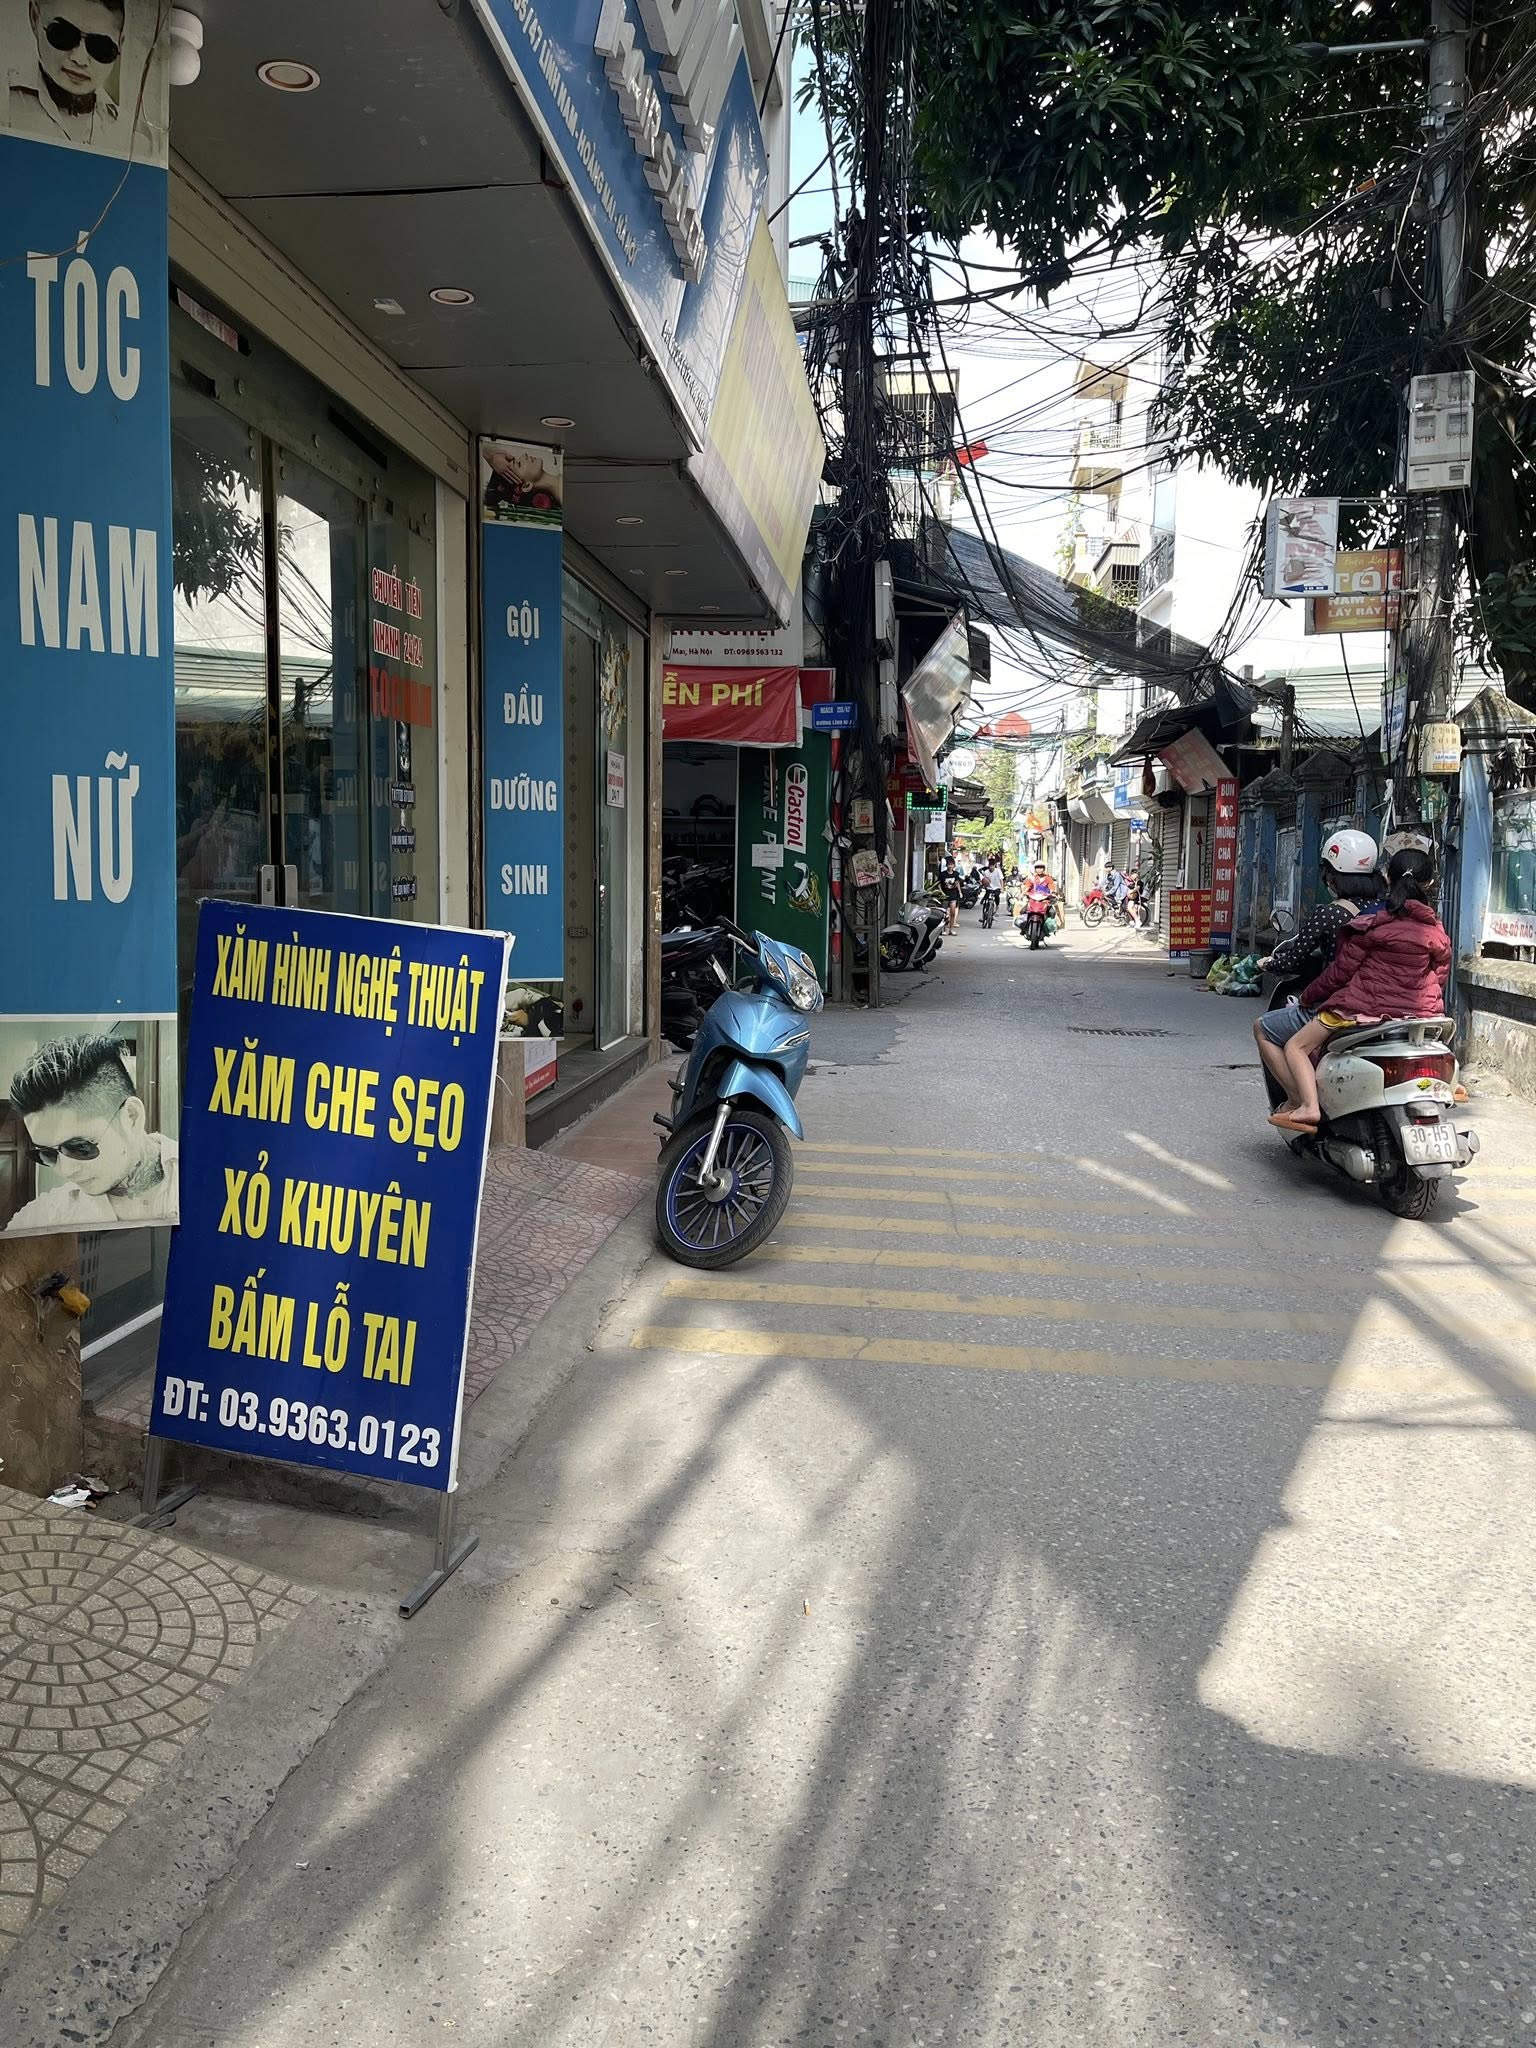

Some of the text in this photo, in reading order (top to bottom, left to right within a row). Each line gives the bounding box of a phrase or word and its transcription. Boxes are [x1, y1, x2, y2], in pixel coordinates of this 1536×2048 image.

[557, 81, 578, 137] NAM
[576, 128, 606, 194] HOÀNG
[601, 183, 617, 222] MAI
[27, 230, 141, 401] TÓC
[18, 512, 159, 657] NAM
[506, 600, 541, 646] GỘI
[373, 618, 400, 661] NHANH
[503, 683, 543, 726] ĐẦU
[662, 671, 766, 706] ỄN PHÍ
[52, 751, 140, 904] NỮ
[490, 772, 557, 812] DƯỠNG
[787, 784, 805, 847] Castrol
[501, 863, 548, 896] SINH
[1216, 868, 1231, 880] NEM
[212, 923, 485, 1046] XĂM HÌNH NGHỆ THUẬT
[207, 1036, 465, 1163] XĂM CHE SẸO
[218, 1150, 431, 1269] XỎ KHUYÊN
[208, 1268, 417, 1387] BẤM LỖ TAI
[163, 1376, 441, 1468] ĐT: 03.9363.0123
